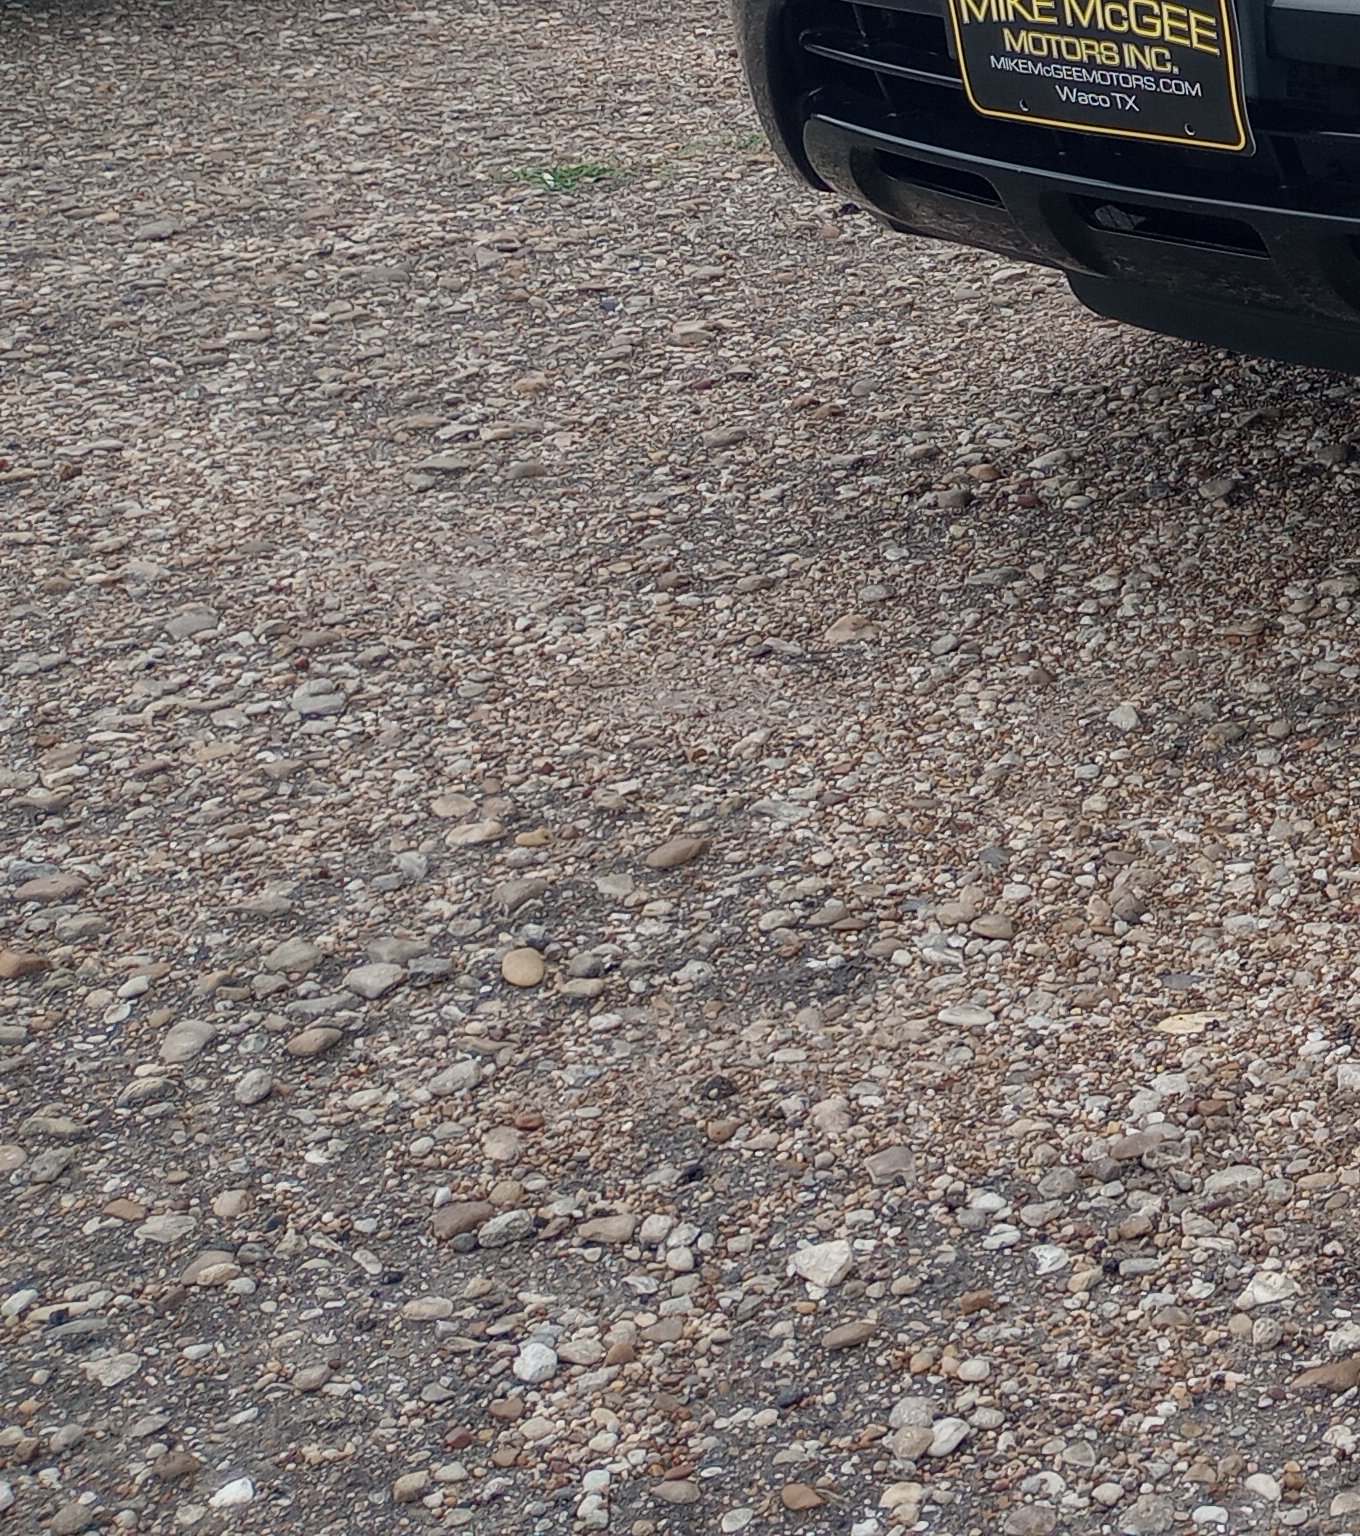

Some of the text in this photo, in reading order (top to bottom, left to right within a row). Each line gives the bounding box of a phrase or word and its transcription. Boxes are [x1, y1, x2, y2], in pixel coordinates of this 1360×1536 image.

[1002, 27, 1180, 74] MOTORS INC.
[1055, 85, 1140, 113] Waco TX
